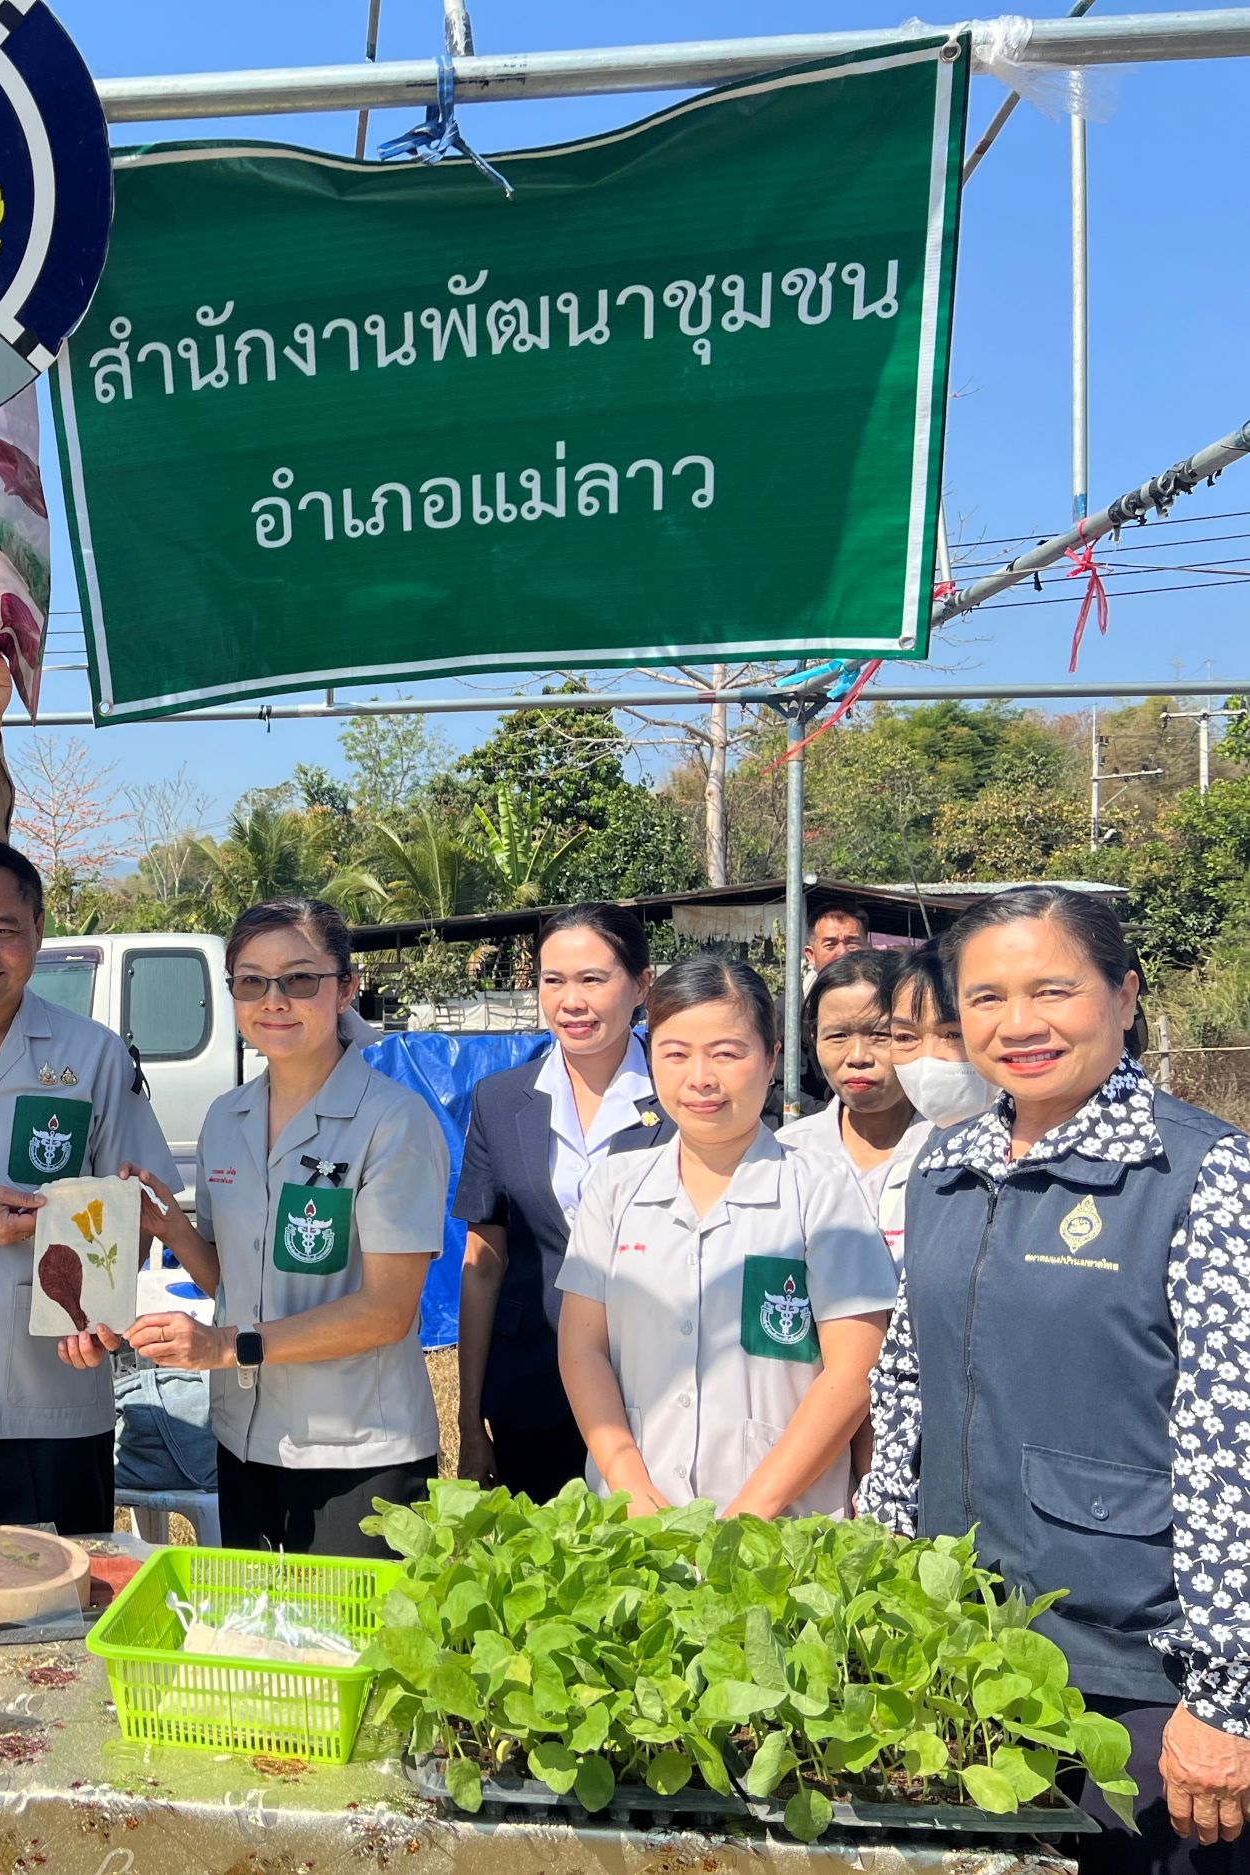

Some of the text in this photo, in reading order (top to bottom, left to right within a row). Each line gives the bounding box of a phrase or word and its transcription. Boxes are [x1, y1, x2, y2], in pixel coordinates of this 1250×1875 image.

[89, 259, 901, 404] สำนักงานพัฒนาชุมชน
[251, 442, 716, 550] อำเภอแม่ลาว
